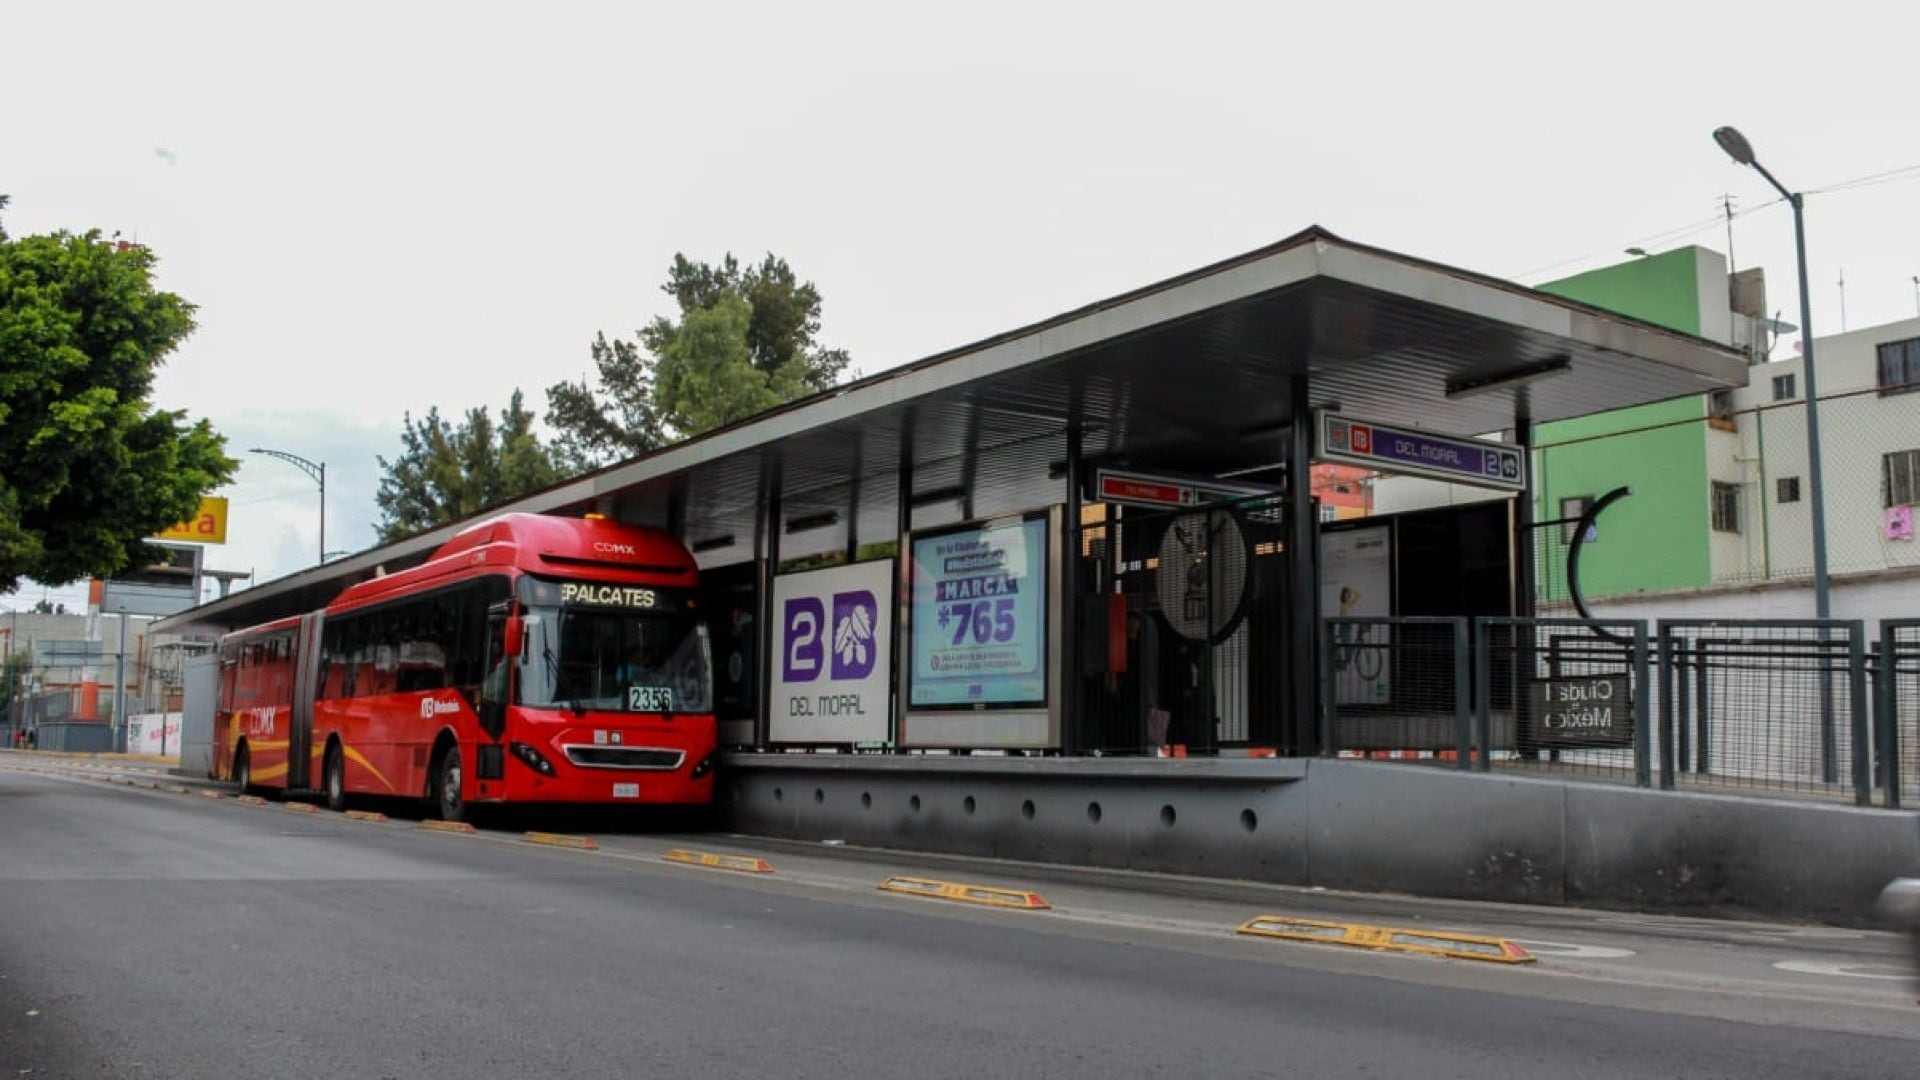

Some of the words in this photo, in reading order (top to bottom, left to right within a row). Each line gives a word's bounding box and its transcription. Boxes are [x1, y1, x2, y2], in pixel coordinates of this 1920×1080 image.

[1395, 440, 1420, 457] DEL
[1420, 445, 1461, 465] MORAL
[1486, 454, 1499, 473] 2
[593, 542, 635, 555] CDMX
[945, 576, 1008, 600] MARCA
[789, 697, 813, 716] DEL
[818, 694, 866, 716] MORAL
